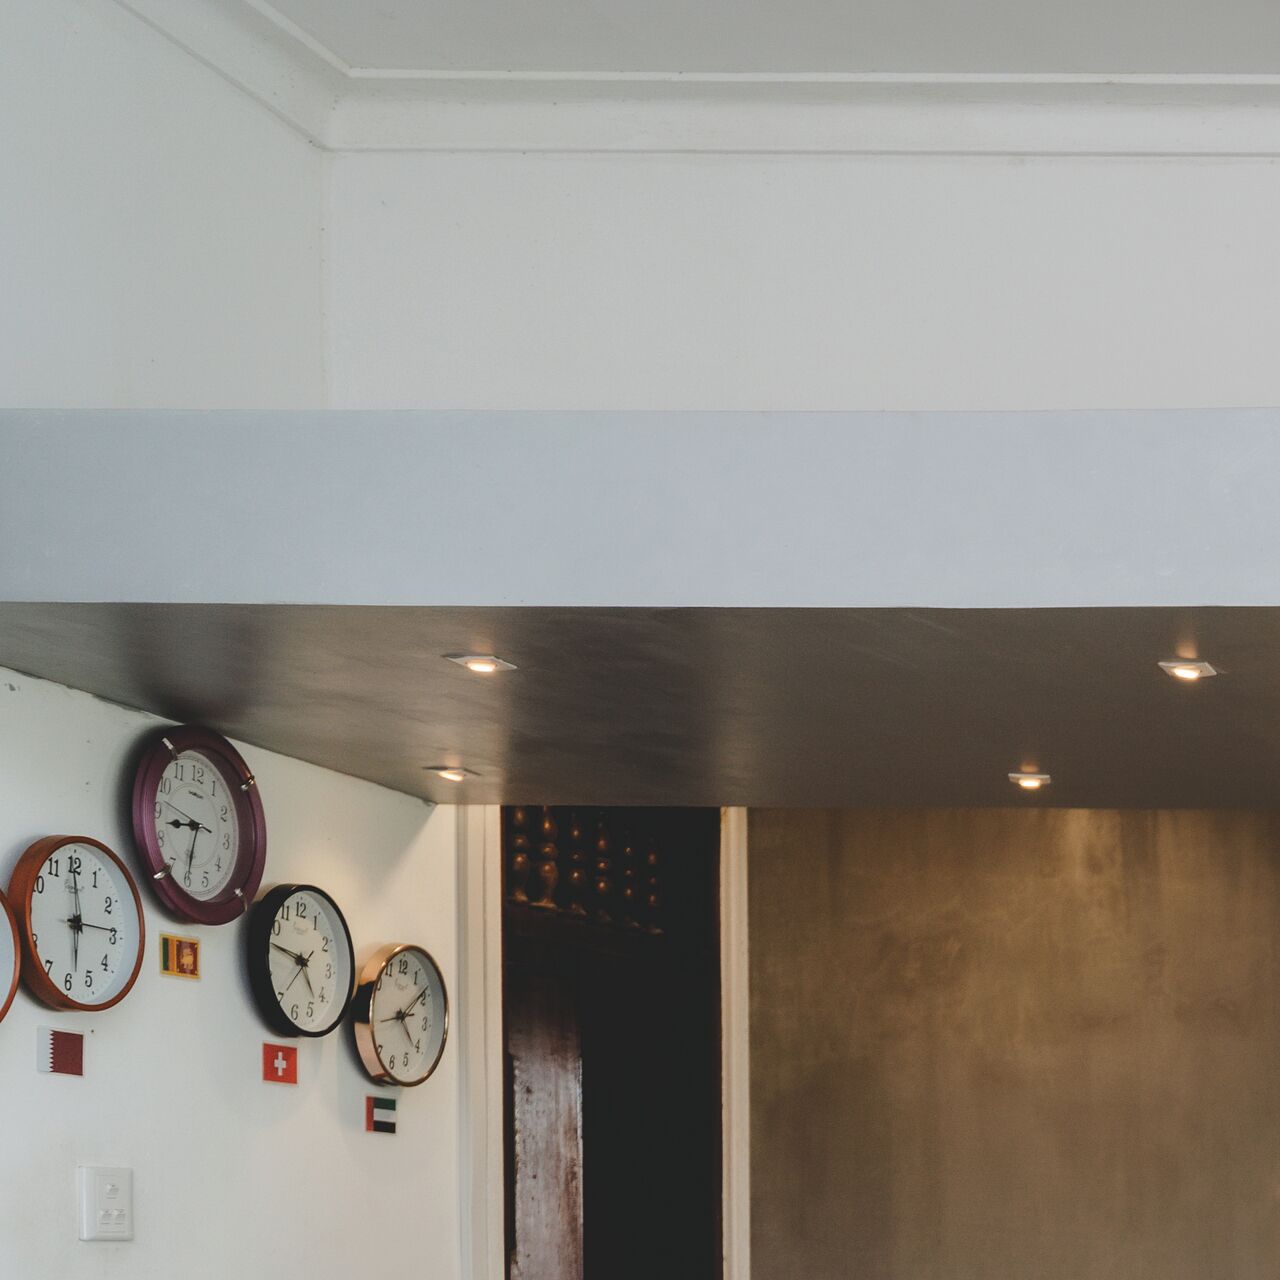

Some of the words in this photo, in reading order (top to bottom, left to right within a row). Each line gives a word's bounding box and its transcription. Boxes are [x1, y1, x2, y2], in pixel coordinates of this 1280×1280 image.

[174, 763, 184, 781] 11
[192, 765, 204, 784] 12
[159, 776, 171, 795] 10
[211, 780, 216, 797] 1
[220, 805, 228, 822] 2
[223, 832, 230, 850] 3
[48, 857, 59, 877] 11
[68, 855, 82, 876] 12
[214, 855, 221, 872] 4
[92, 871, 98, 888] 1
[184, 870, 192, 888] 6
[201, 870, 209, 888] 5
[104, 896, 112, 915] 2
[280, 902, 290, 921] 11
[295, 901, 307, 919] 12
[313, 915, 318, 931] 1
[109, 927, 117, 945] 3
[322, 936, 329, 952] 2
[44, 959, 53, 977] 7
[101, 953, 108, 972] 4
[325, 963, 332, 979] 3
[398, 958, 408, 975] 12
[64, 972, 73, 991] 6
[85, 970, 93, 987] 5
[290, 1003, 299, 1020] 6
[306, 1001, 314, 1018] 5
[389, 1055, 395, 1070] 6
[403, 1053, 409, 1067] 5
